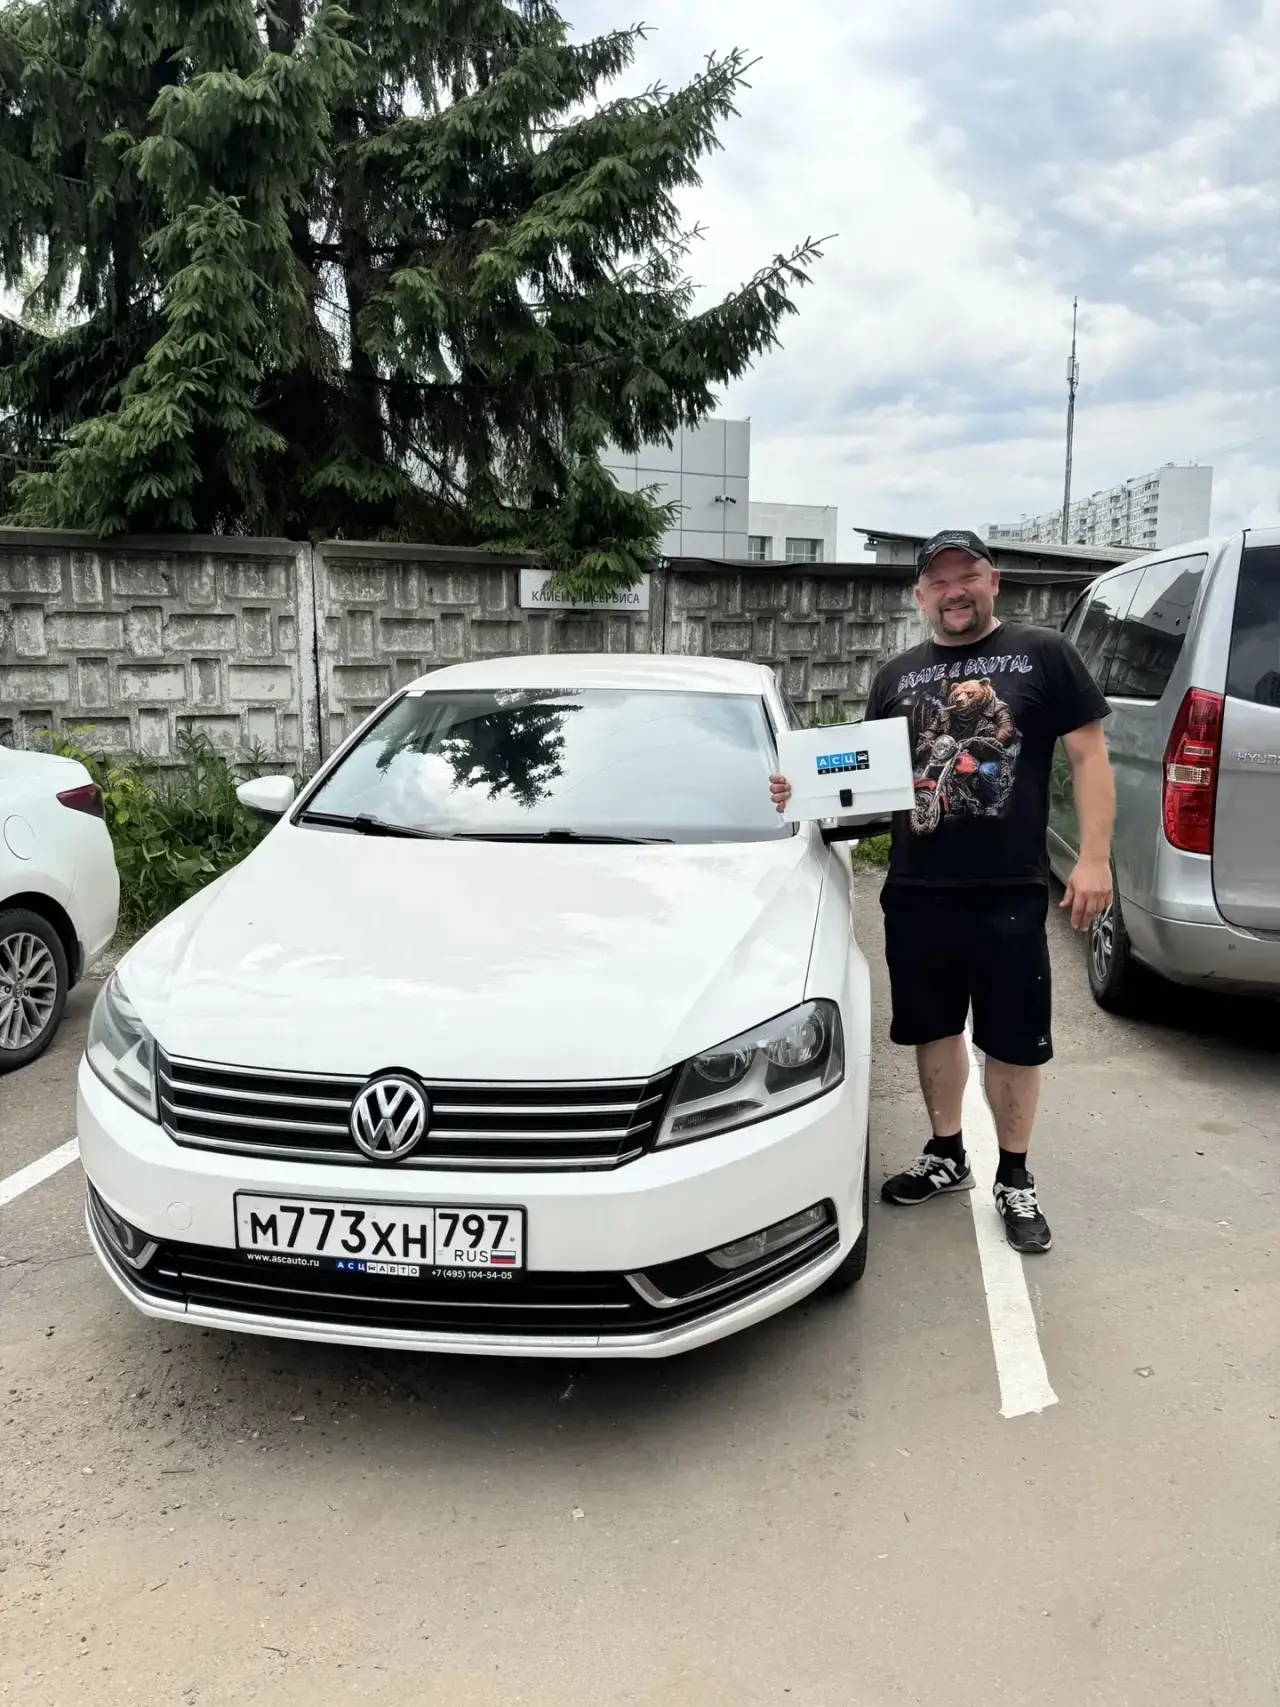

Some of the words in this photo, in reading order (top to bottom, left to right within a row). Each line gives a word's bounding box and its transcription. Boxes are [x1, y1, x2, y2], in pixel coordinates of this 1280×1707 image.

[897, 663, 947, 693] BRAVE
[948, 661, 962, 678] &
[964, 655, 1033, 676] BRUTAL
[438, 1212, 509, 1249] 797
[246, 1252, 320, 1267] www.ascauto.ru
[454, 1250, 489, 1263] RUS
[431, 1269, 442, 1277] +7
[442, 1269, 466, 1279] (495)
[467, 1270, 513, 1280] 104-54-05
